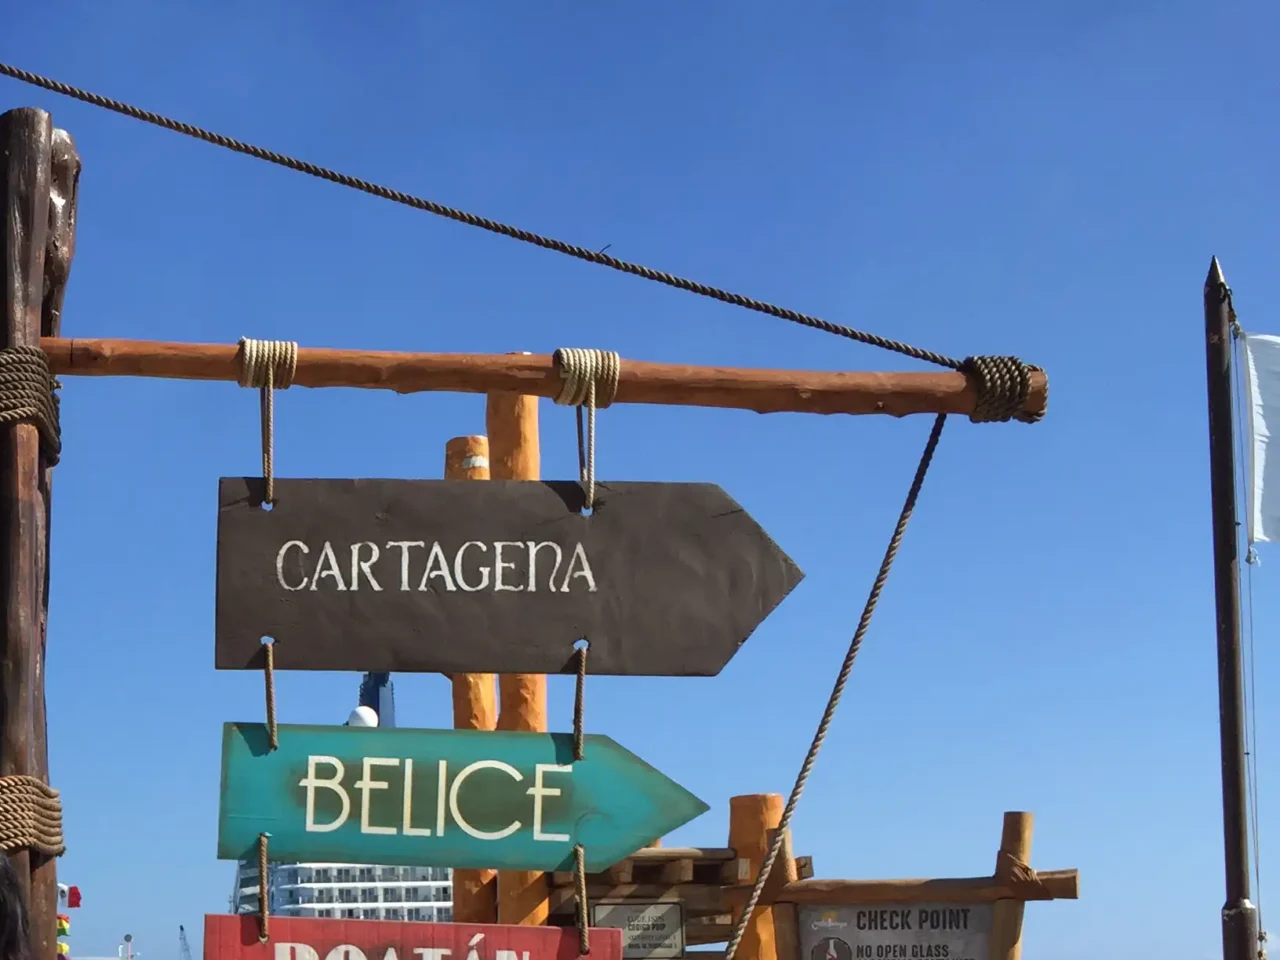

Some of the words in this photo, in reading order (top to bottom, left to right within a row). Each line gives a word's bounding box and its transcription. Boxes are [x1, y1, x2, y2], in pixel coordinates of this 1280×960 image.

[275, 539, 598, 593] CARTAGENA
[297, 754, 573, 843] BELICE
[856, 909, 912, 931] CHECK
[918, 908, 971, 930] POINT
[856, 945, 871, 958] NO
[876, 945, 907, 958] OPEN
[911, 945, 949, 958] GLASS
